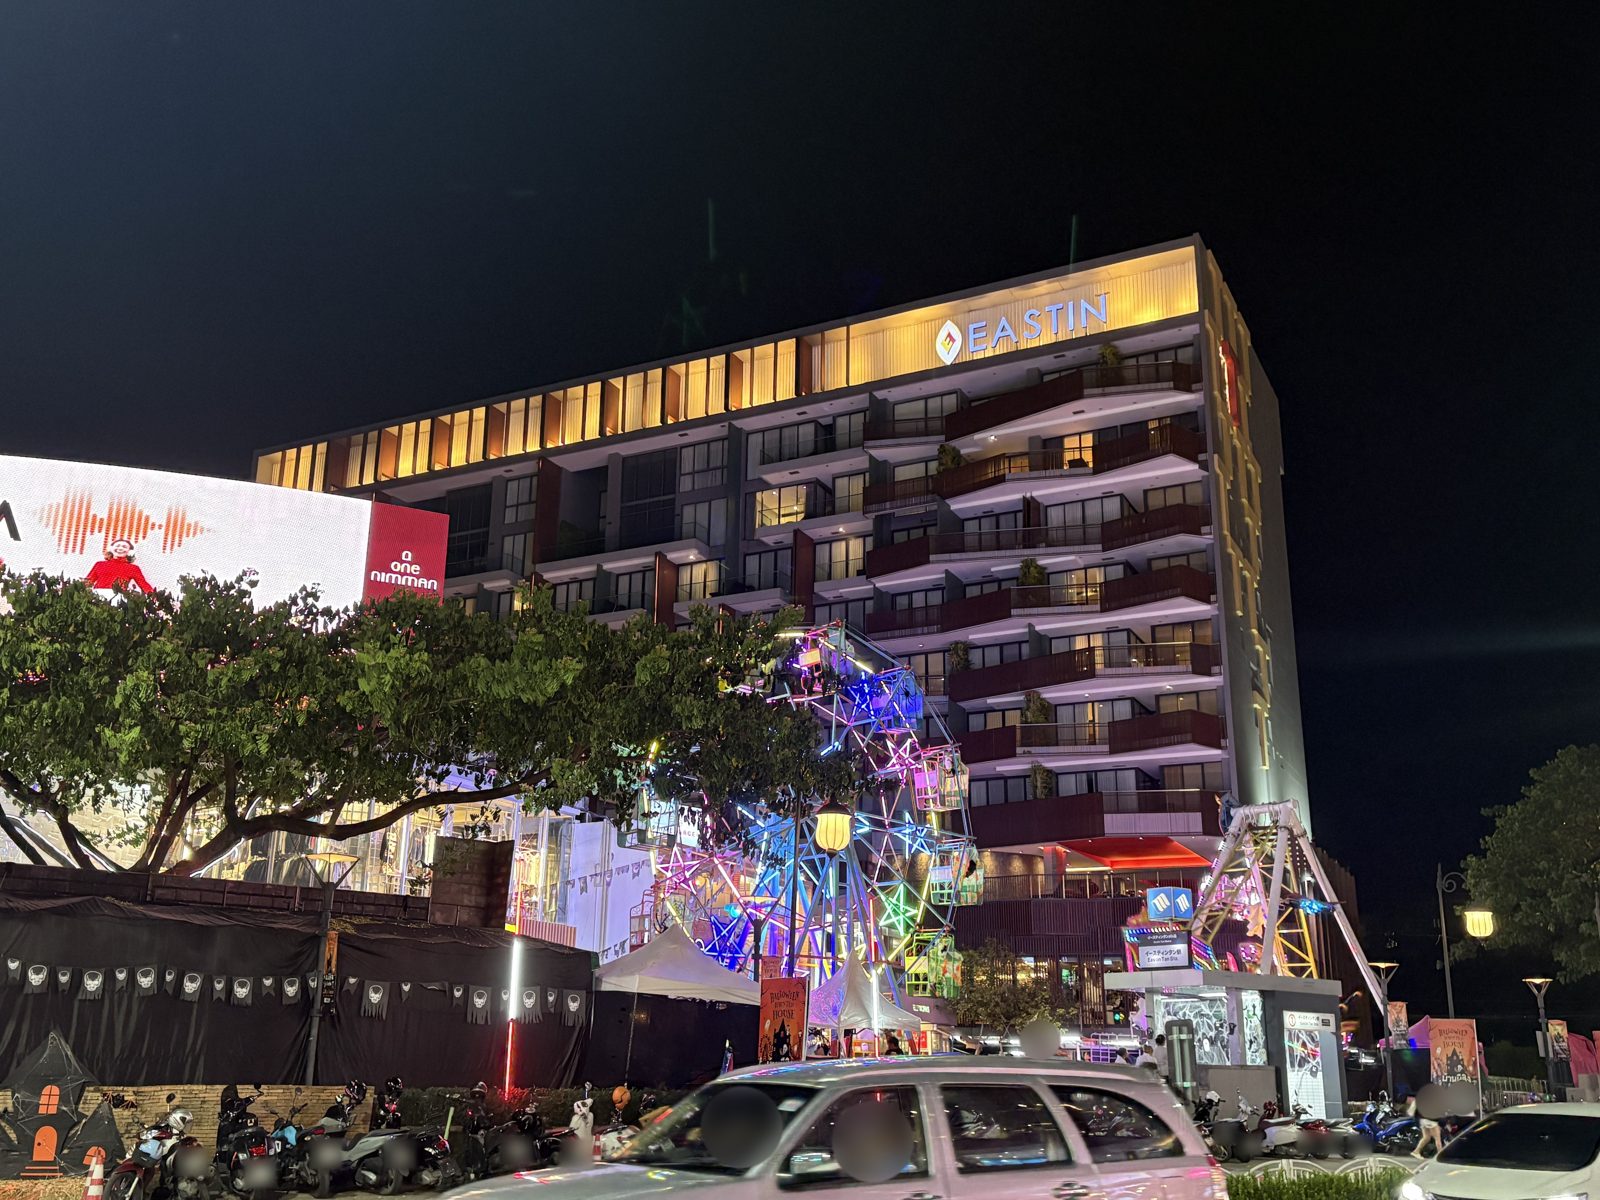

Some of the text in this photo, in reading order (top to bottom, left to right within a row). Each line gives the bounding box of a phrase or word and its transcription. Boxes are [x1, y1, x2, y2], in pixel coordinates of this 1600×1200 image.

[968, 293, 1107, 353] EASTIN
[390, 561, 421, 575] one
[772, 1009, 795, 1021] HOUSE
